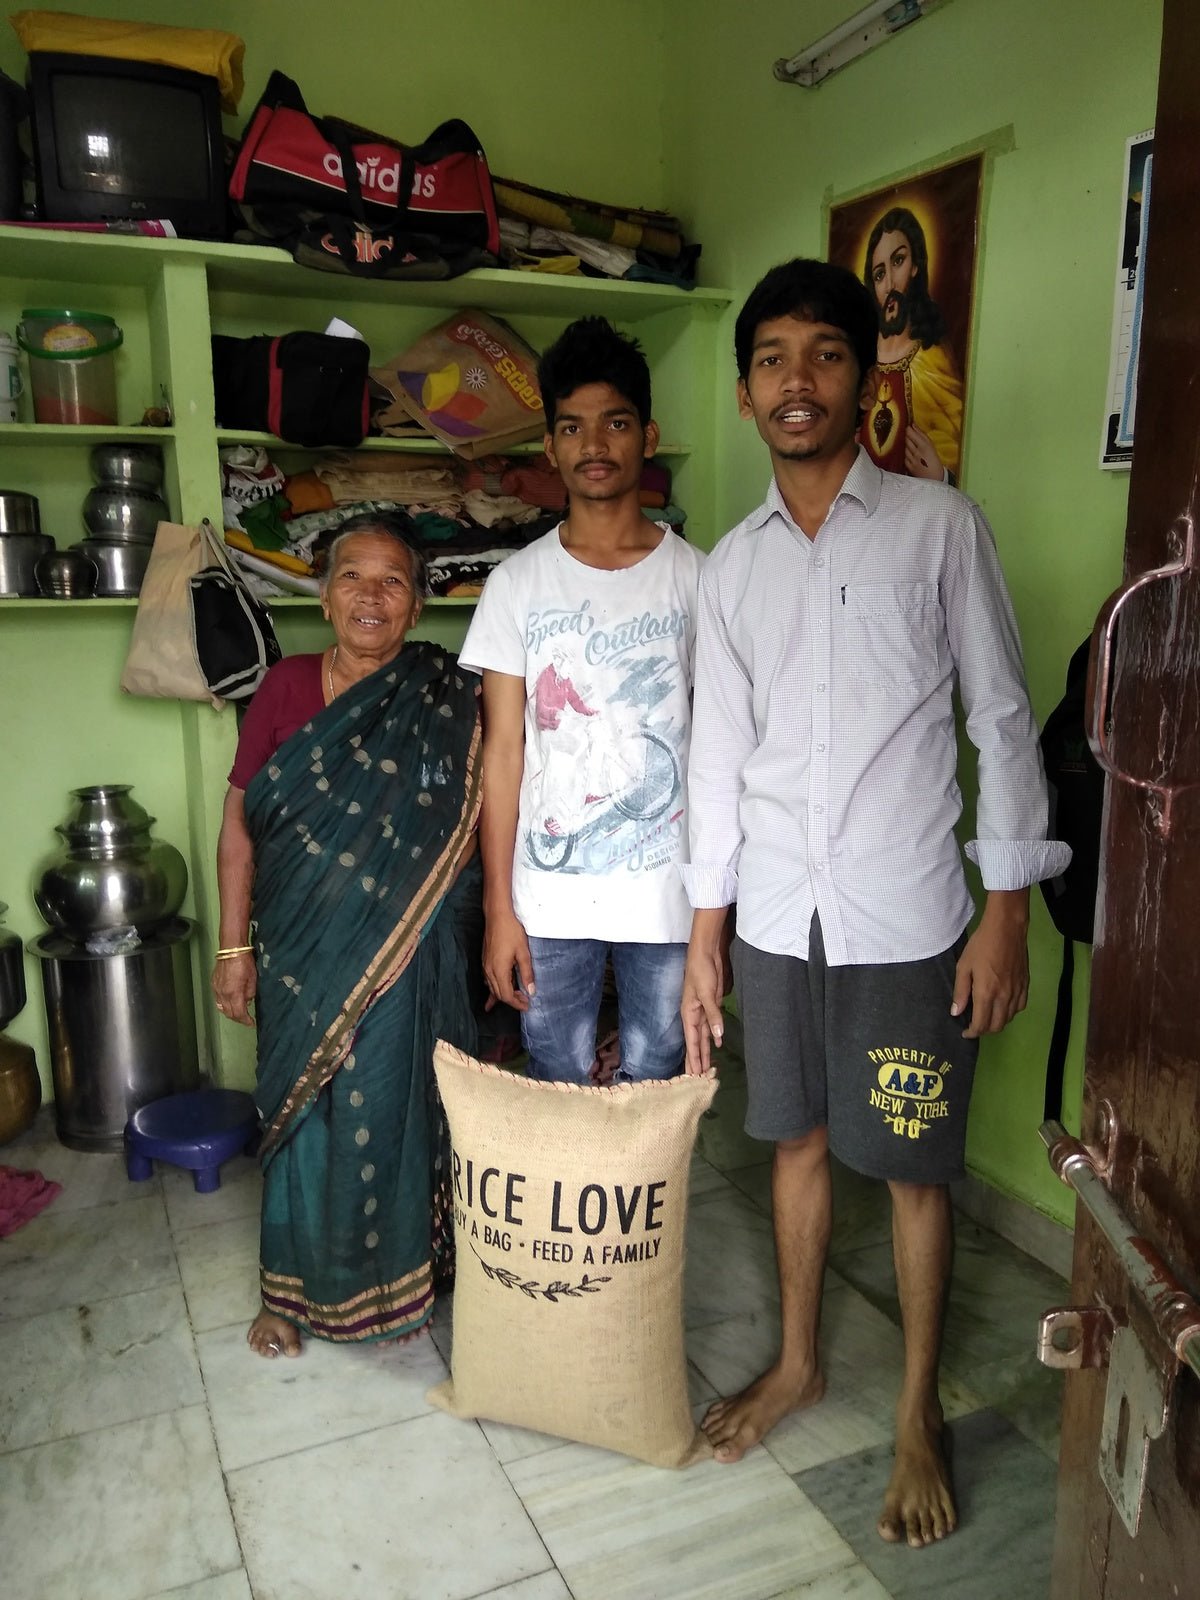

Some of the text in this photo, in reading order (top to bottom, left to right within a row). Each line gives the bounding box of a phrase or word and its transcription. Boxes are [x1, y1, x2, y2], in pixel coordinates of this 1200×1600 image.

[527, 599, 595, 655] Speed
[867, 1047, 953, 1076] PROPERTY OF
[885, 1068, 939, 1097] A&F
[869, 1087, 949, 1120] NEW YORK
[452, 1147, 667, 1236] RICE LOVE
[471, 1219, 479, 1240] A
[484, 1224, 512, 1252] BAG
[532, 1239, 574, 1264] FEED
[583, 1245, 595, 1265] A
[602, 1236, 662, 1265] FAMILY
